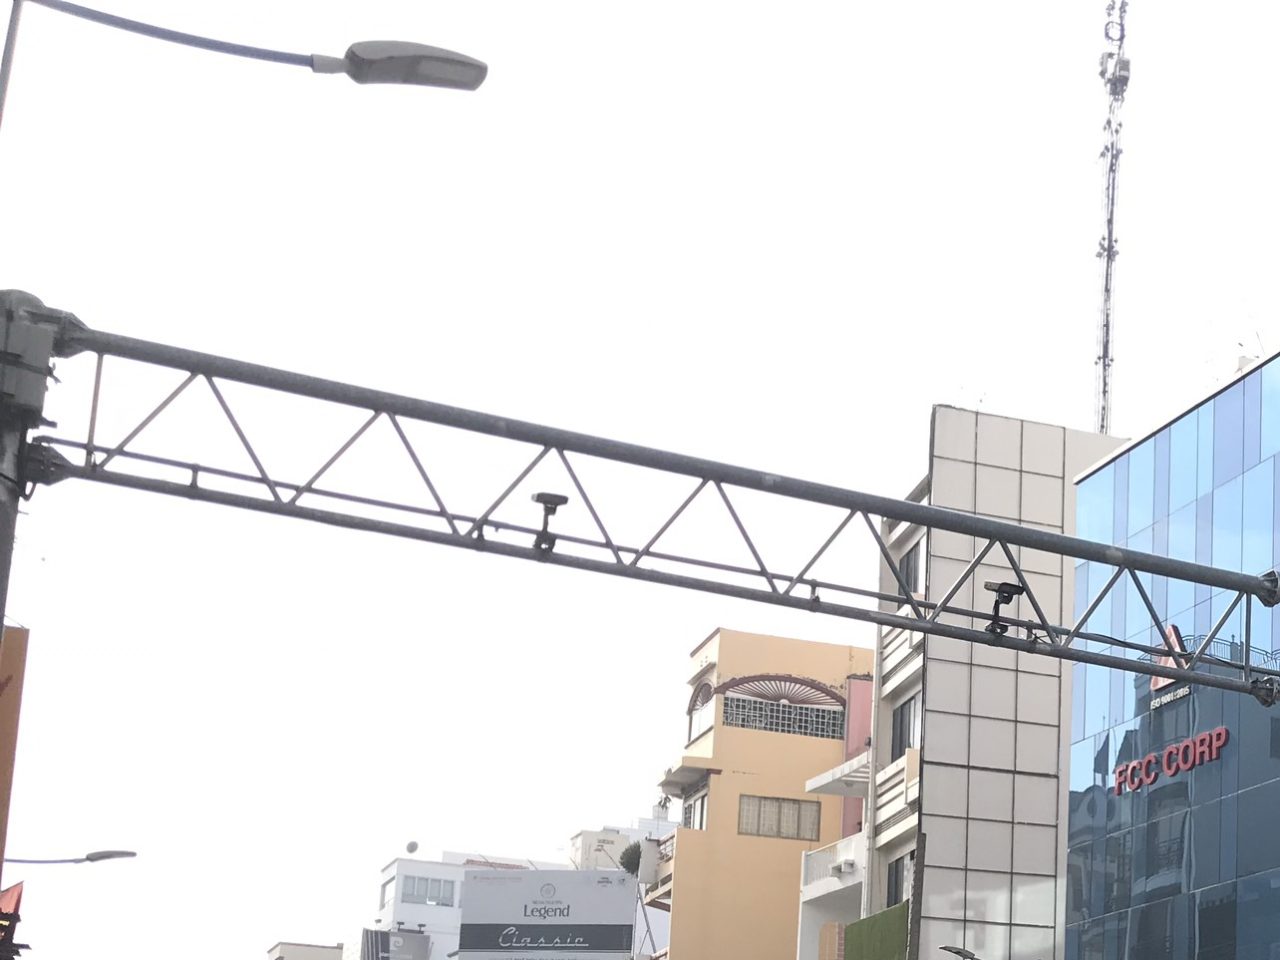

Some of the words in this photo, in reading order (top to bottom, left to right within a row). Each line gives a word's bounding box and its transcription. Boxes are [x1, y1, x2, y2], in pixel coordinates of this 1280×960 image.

[1150, 697, 1161, 711] ISO
[1113, 752, 1160, 796] FCC
[1162, 727, 1230, 777] CORP
[523, 904, 570, 919] Legend
[499, 926, 589, 947] Classic
